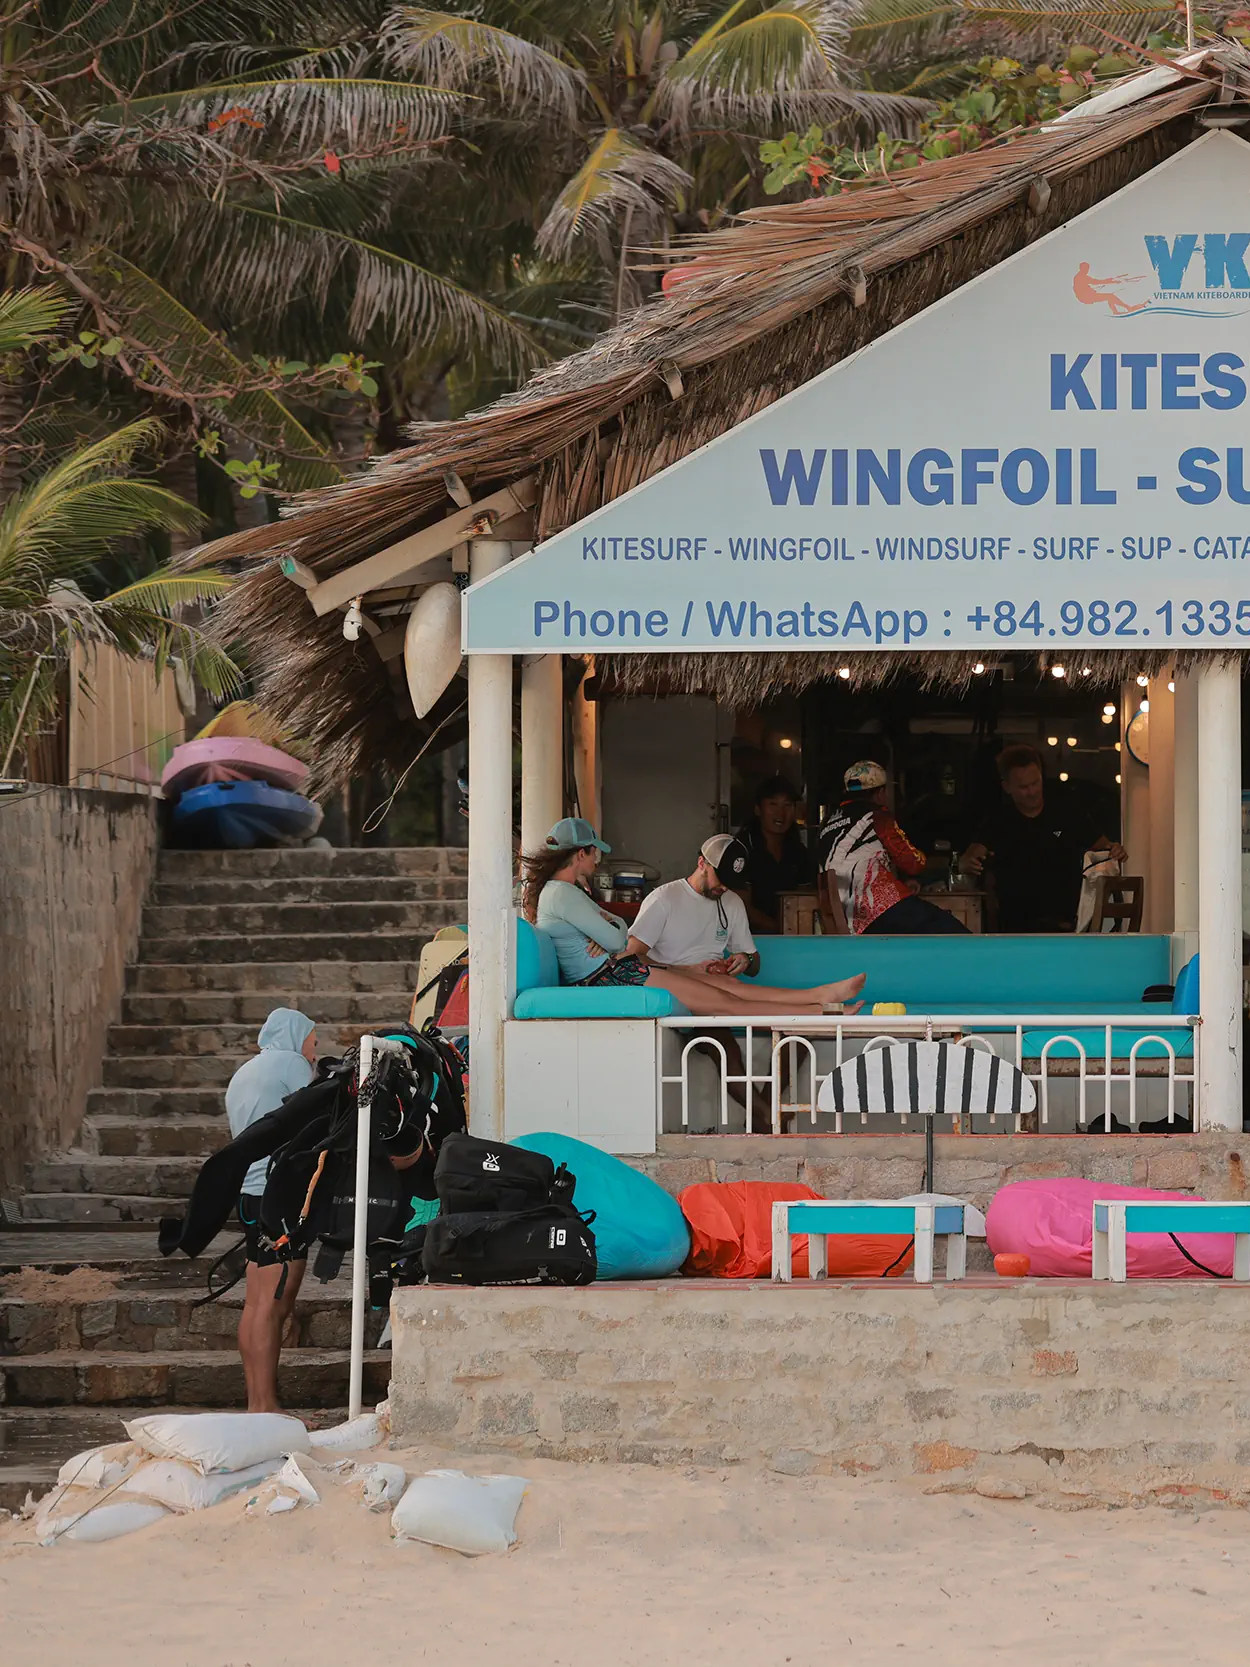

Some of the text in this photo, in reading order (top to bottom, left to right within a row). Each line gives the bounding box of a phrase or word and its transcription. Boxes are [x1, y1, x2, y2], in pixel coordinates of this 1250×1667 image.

[1153, 291, 1195, 300] VIETNAM
[759, 447, 1118, 507] WINGFOIL
[1136, 475, 1158, 491] -
[582, 536, 708, 561] KITESURF
[728, 537, 856, 562] WINGFOIL
[875, 536, 1012, 561] WINDSURF
[1032, 536, 1100, 561] SURF
[1121, 536, 1172, 561] SUP
[534, 600, 669, 638] Phone
[705, 600, 928, 645] WhatsApp
